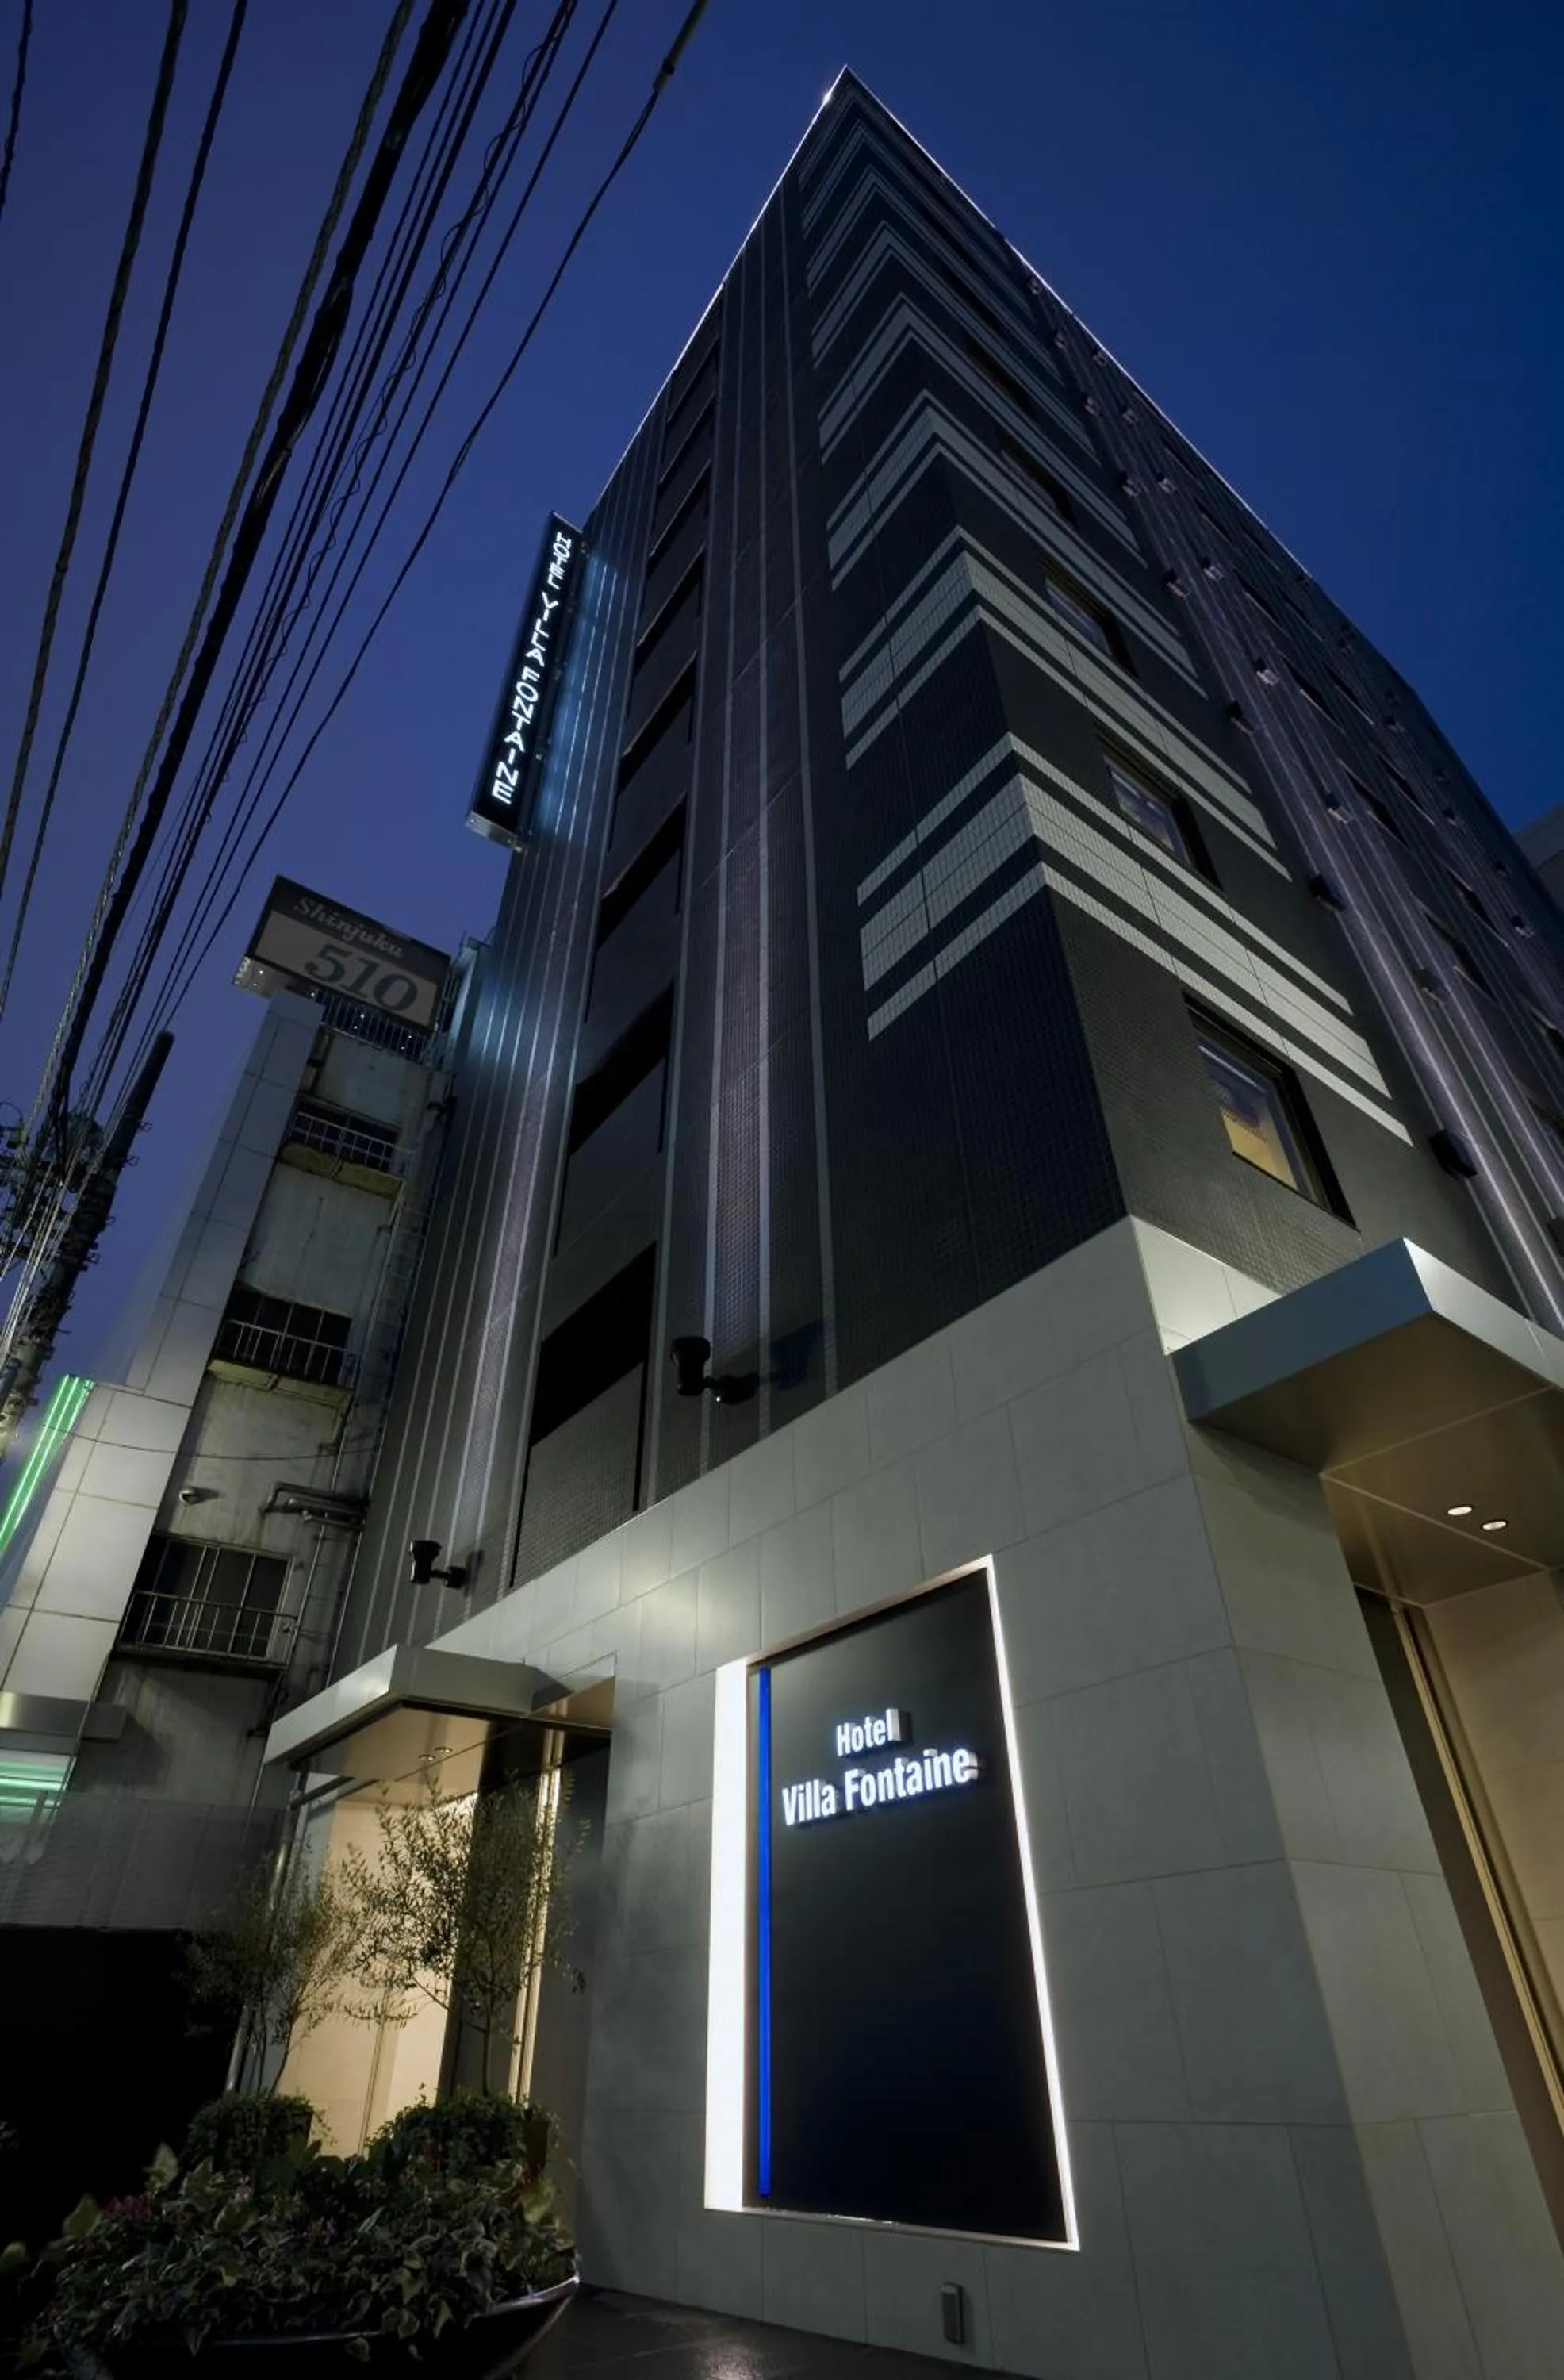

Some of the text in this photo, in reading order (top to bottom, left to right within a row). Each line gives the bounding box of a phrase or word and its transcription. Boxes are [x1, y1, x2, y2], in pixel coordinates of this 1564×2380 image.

[490, 531, 572, 805] HOTEL VILLA FONTAINE
[293, 896, 404, 958] Shinjuku
[304, 942, 419, 1012] 510
[836, 1708, 902, 1757] Hotel
[781, 1748, 975, 1826] Villa Fontaine
